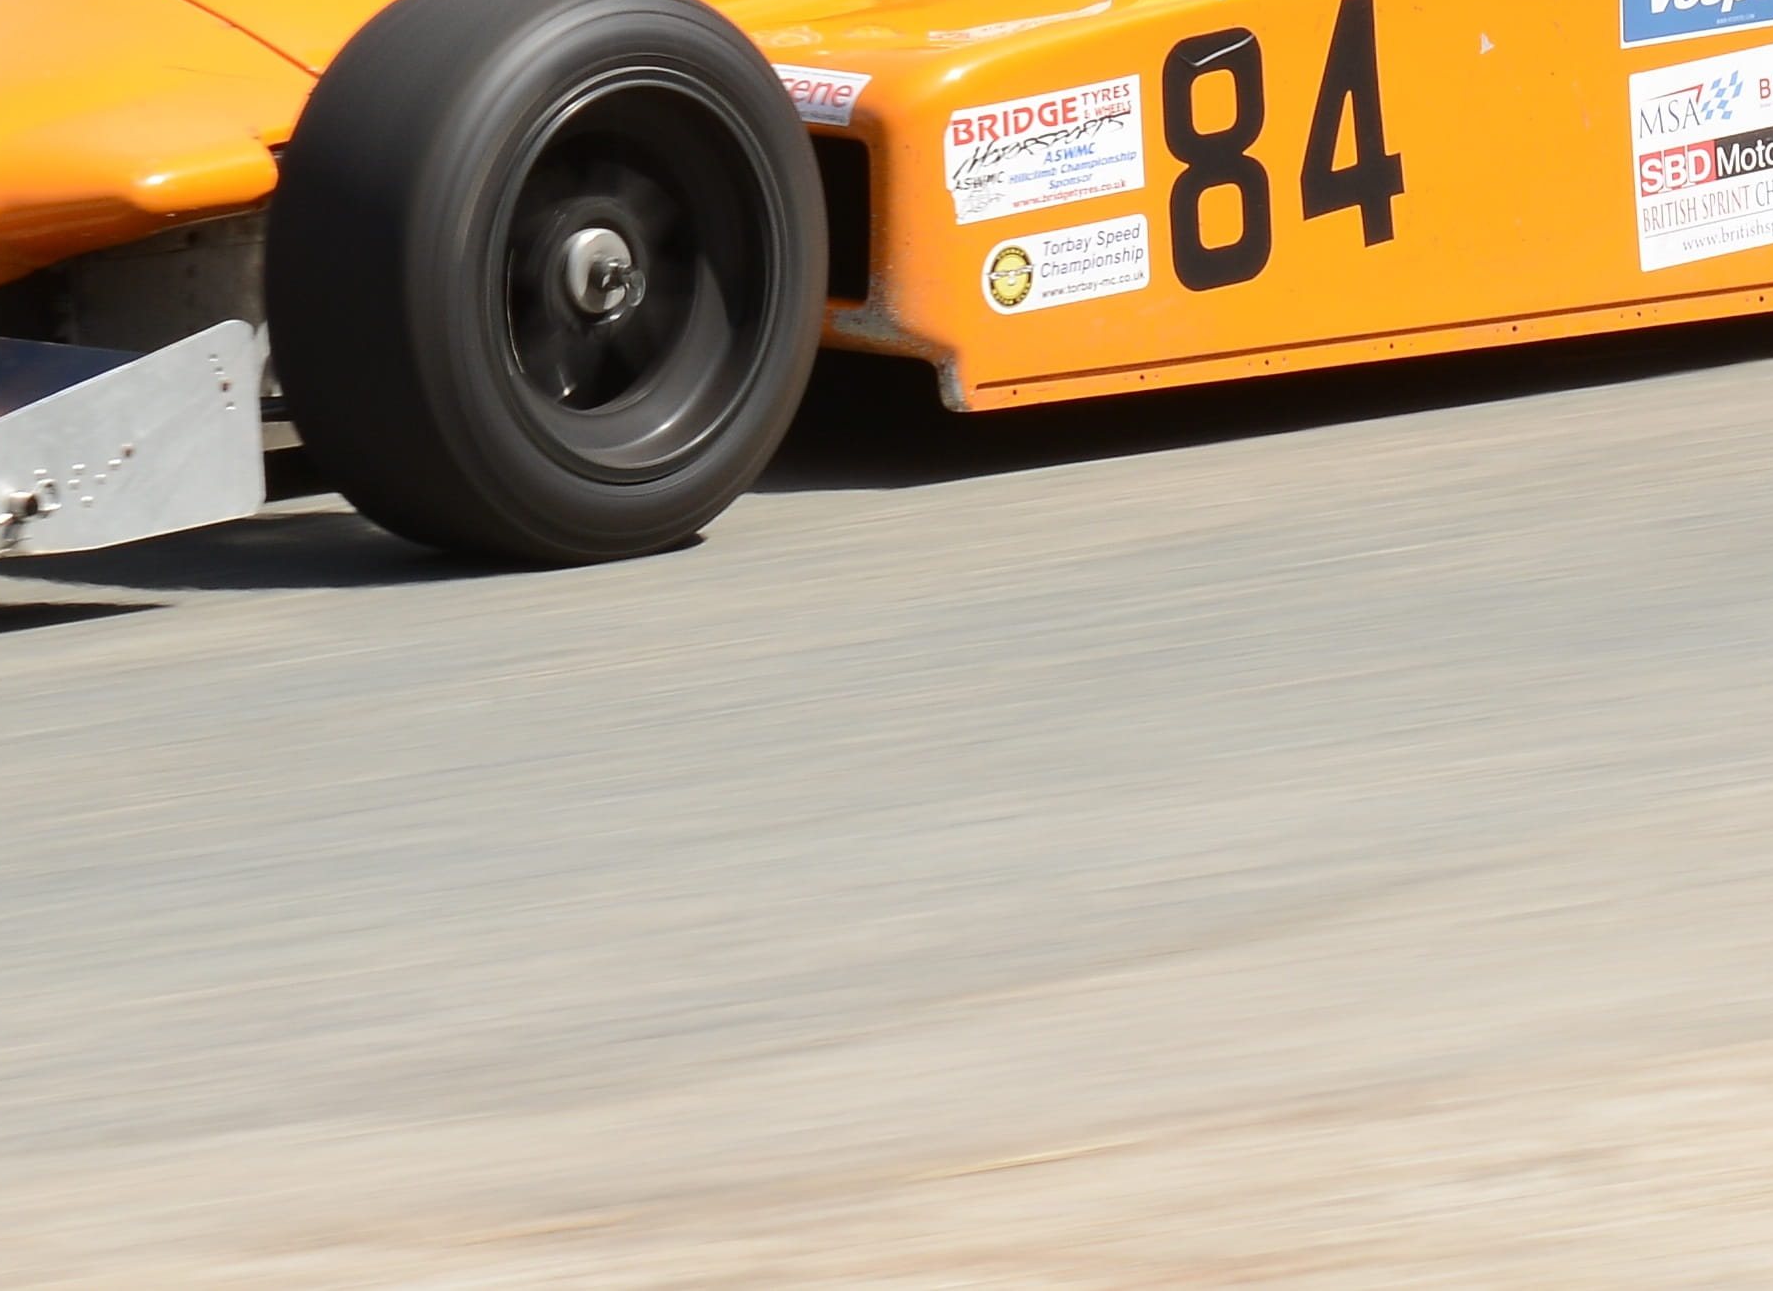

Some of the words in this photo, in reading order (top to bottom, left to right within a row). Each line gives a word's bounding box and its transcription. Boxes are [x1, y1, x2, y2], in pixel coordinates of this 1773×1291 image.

[952, 96, 1079, 147] BRIDGE
[1082, 83, 1131, 106] TYRES
[1094, 100, 1133, 118] WHEELS
[1639, 97, 1702, 139] MSA
[1044, 142, 1097, 165] ASWMC
[1060, 150, 1138, 176] Championship
[1641, 148, 1712, 196] SBD
[1643, 198, 1698, 233] BRITISH
[1702, 184, 1751, 220] SPRINT
[1042, 236, 1092, 257] Torbay
[1096, 222, 1141, 248] Speed
[1040, 246, 1145, 279] Championship
